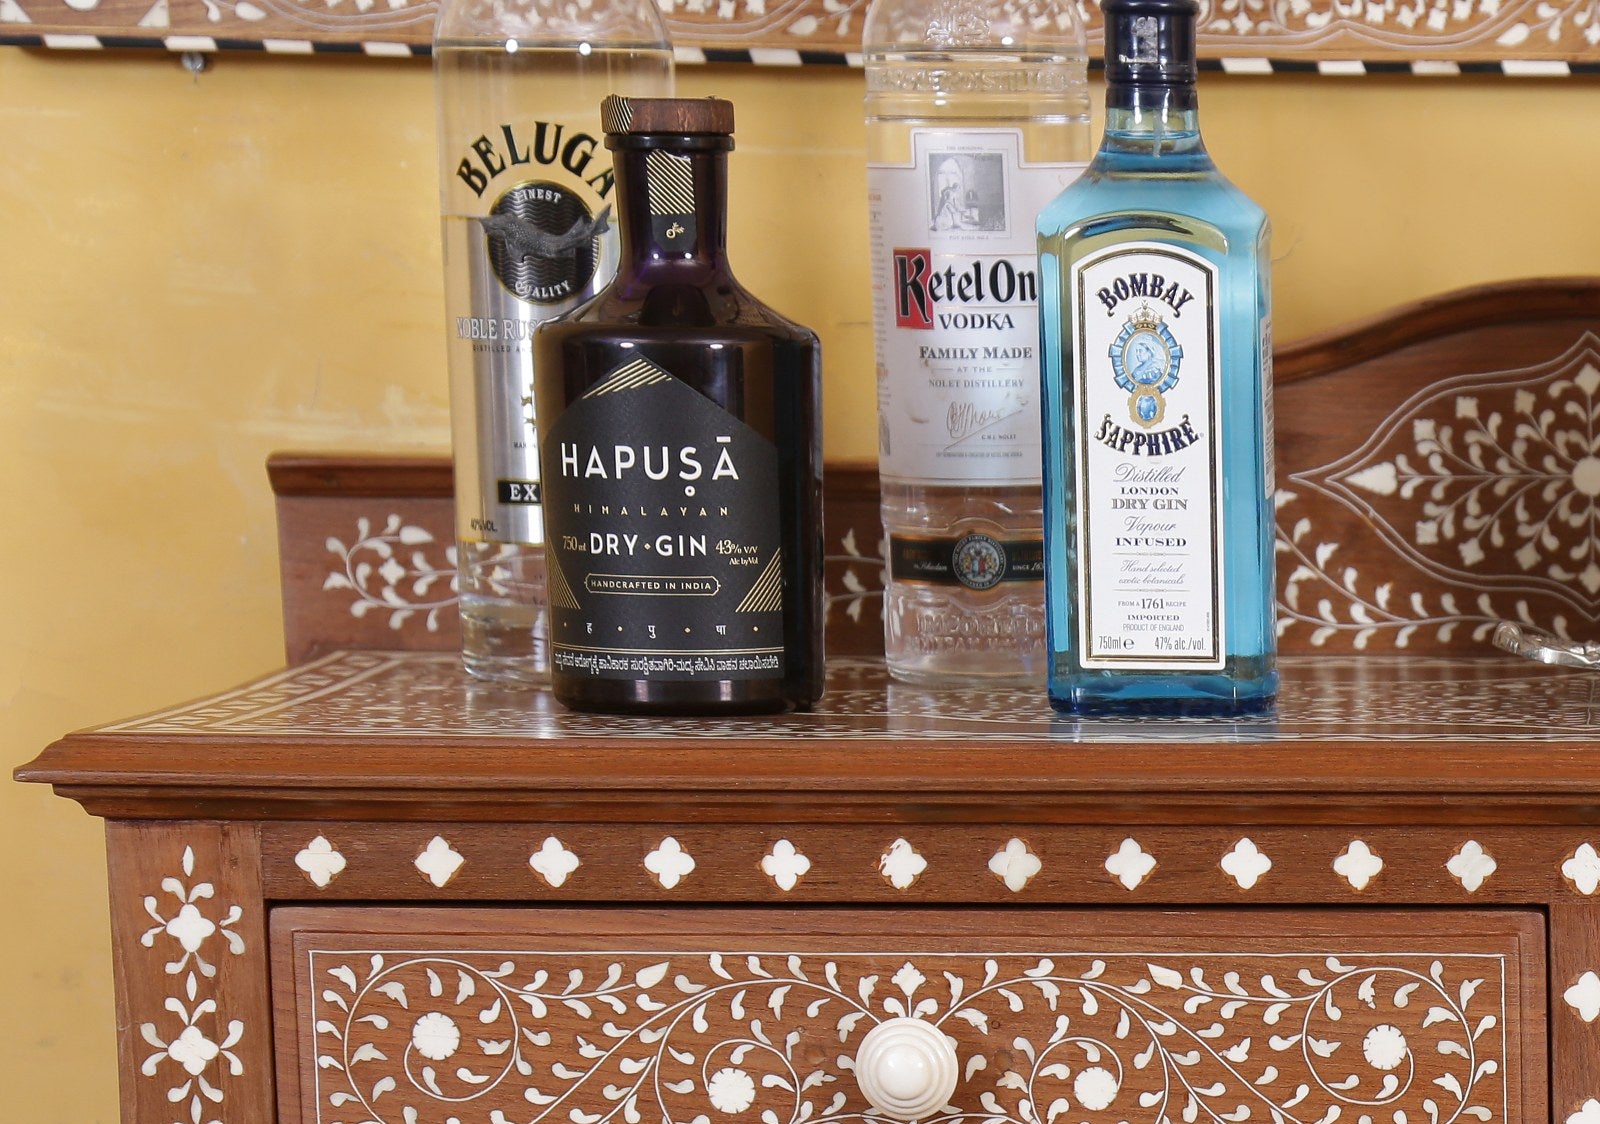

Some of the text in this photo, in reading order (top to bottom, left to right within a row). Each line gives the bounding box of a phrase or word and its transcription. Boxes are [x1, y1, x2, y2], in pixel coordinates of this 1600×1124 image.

[456, 121, 614, 199] BELUGA
[514, 188, 562, 204] FINEST
[515, 280, 571, 298] QUALITY
[895, 254, 1038, 324] Ketel On
[1095, 273, 1194, 318] BOMBAY
[456, 317, 498, 341] NOBLE
[938, 313, 1015, 331] VODKA
[919, 346, 1032, 359] FAMILY MADE
[928, 379, 1025, 388] NOLET DISTILLERY
[1094, 413, 1199, 456] SAPPHIRE
[1113, 462, 1186, 483] Distilled
[510, 484, 538, 501] EX
[1120, 486, 1179, 496] LONDON
[574, 503, 728, 517] HIMALAYAN
[1111, 498, 1188, 511] DRY GIN
[1124, 515, 1177, 536] Vapour
[562, 536, 578, 551] 750
[589, 533, 638, 556] DRY
[655, 534, 707, 557] GIN
[715, 539, 742, 555] 43%
[1115, 537, 1187, 547] INFUSED
[591, 580, 712, 590] HANDCRAFTED IN INDIA
[1141, 598, 1165, 610] 1761
[1122, 623, 1185, 632] PRODUCT OF ENGLAND
[1098, 635, 1121, 650] 750ml
[1154, 636, 1173, 650] 47%
